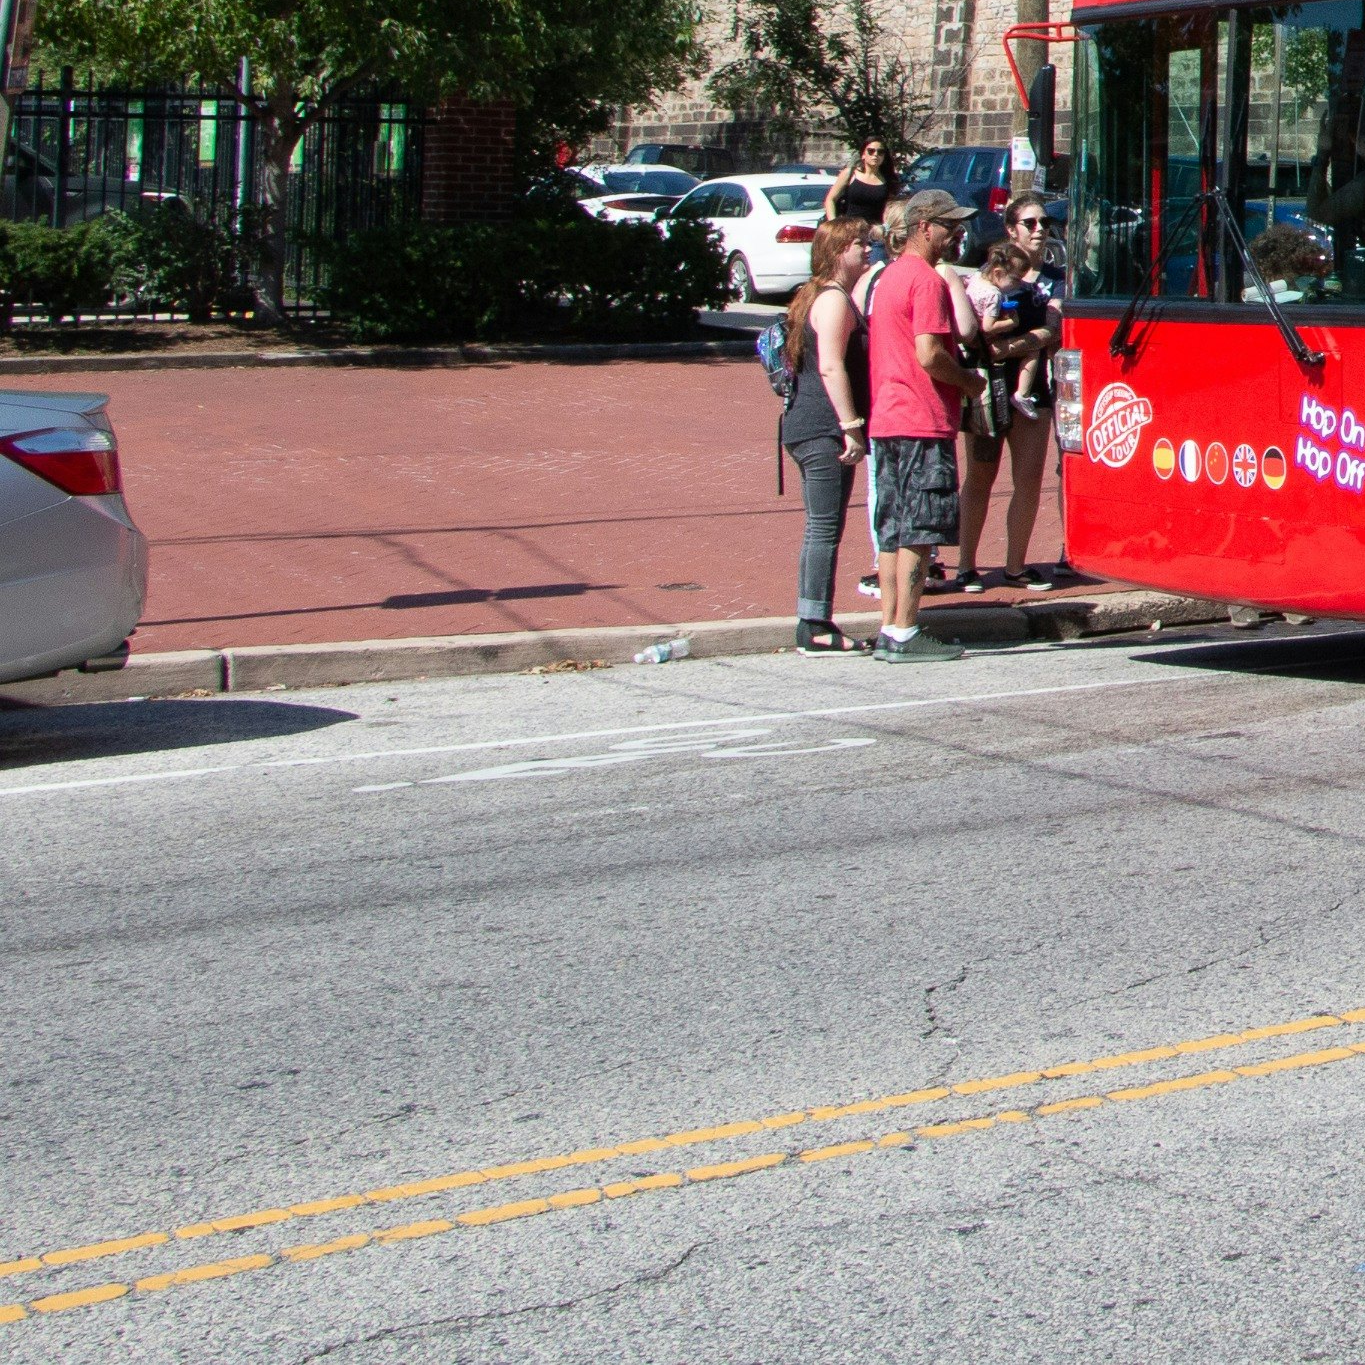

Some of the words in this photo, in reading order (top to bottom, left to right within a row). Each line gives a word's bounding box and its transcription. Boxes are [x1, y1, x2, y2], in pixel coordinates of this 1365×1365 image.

[1093, 402, 1149, 452] OFFICIAL
[1302, 396, 1337, 438] Hop
[1341, 410, 1365, 448] On
[1111, 434, 1136, 460] TOUR
[1296, 436, 1332, 479] Hop
